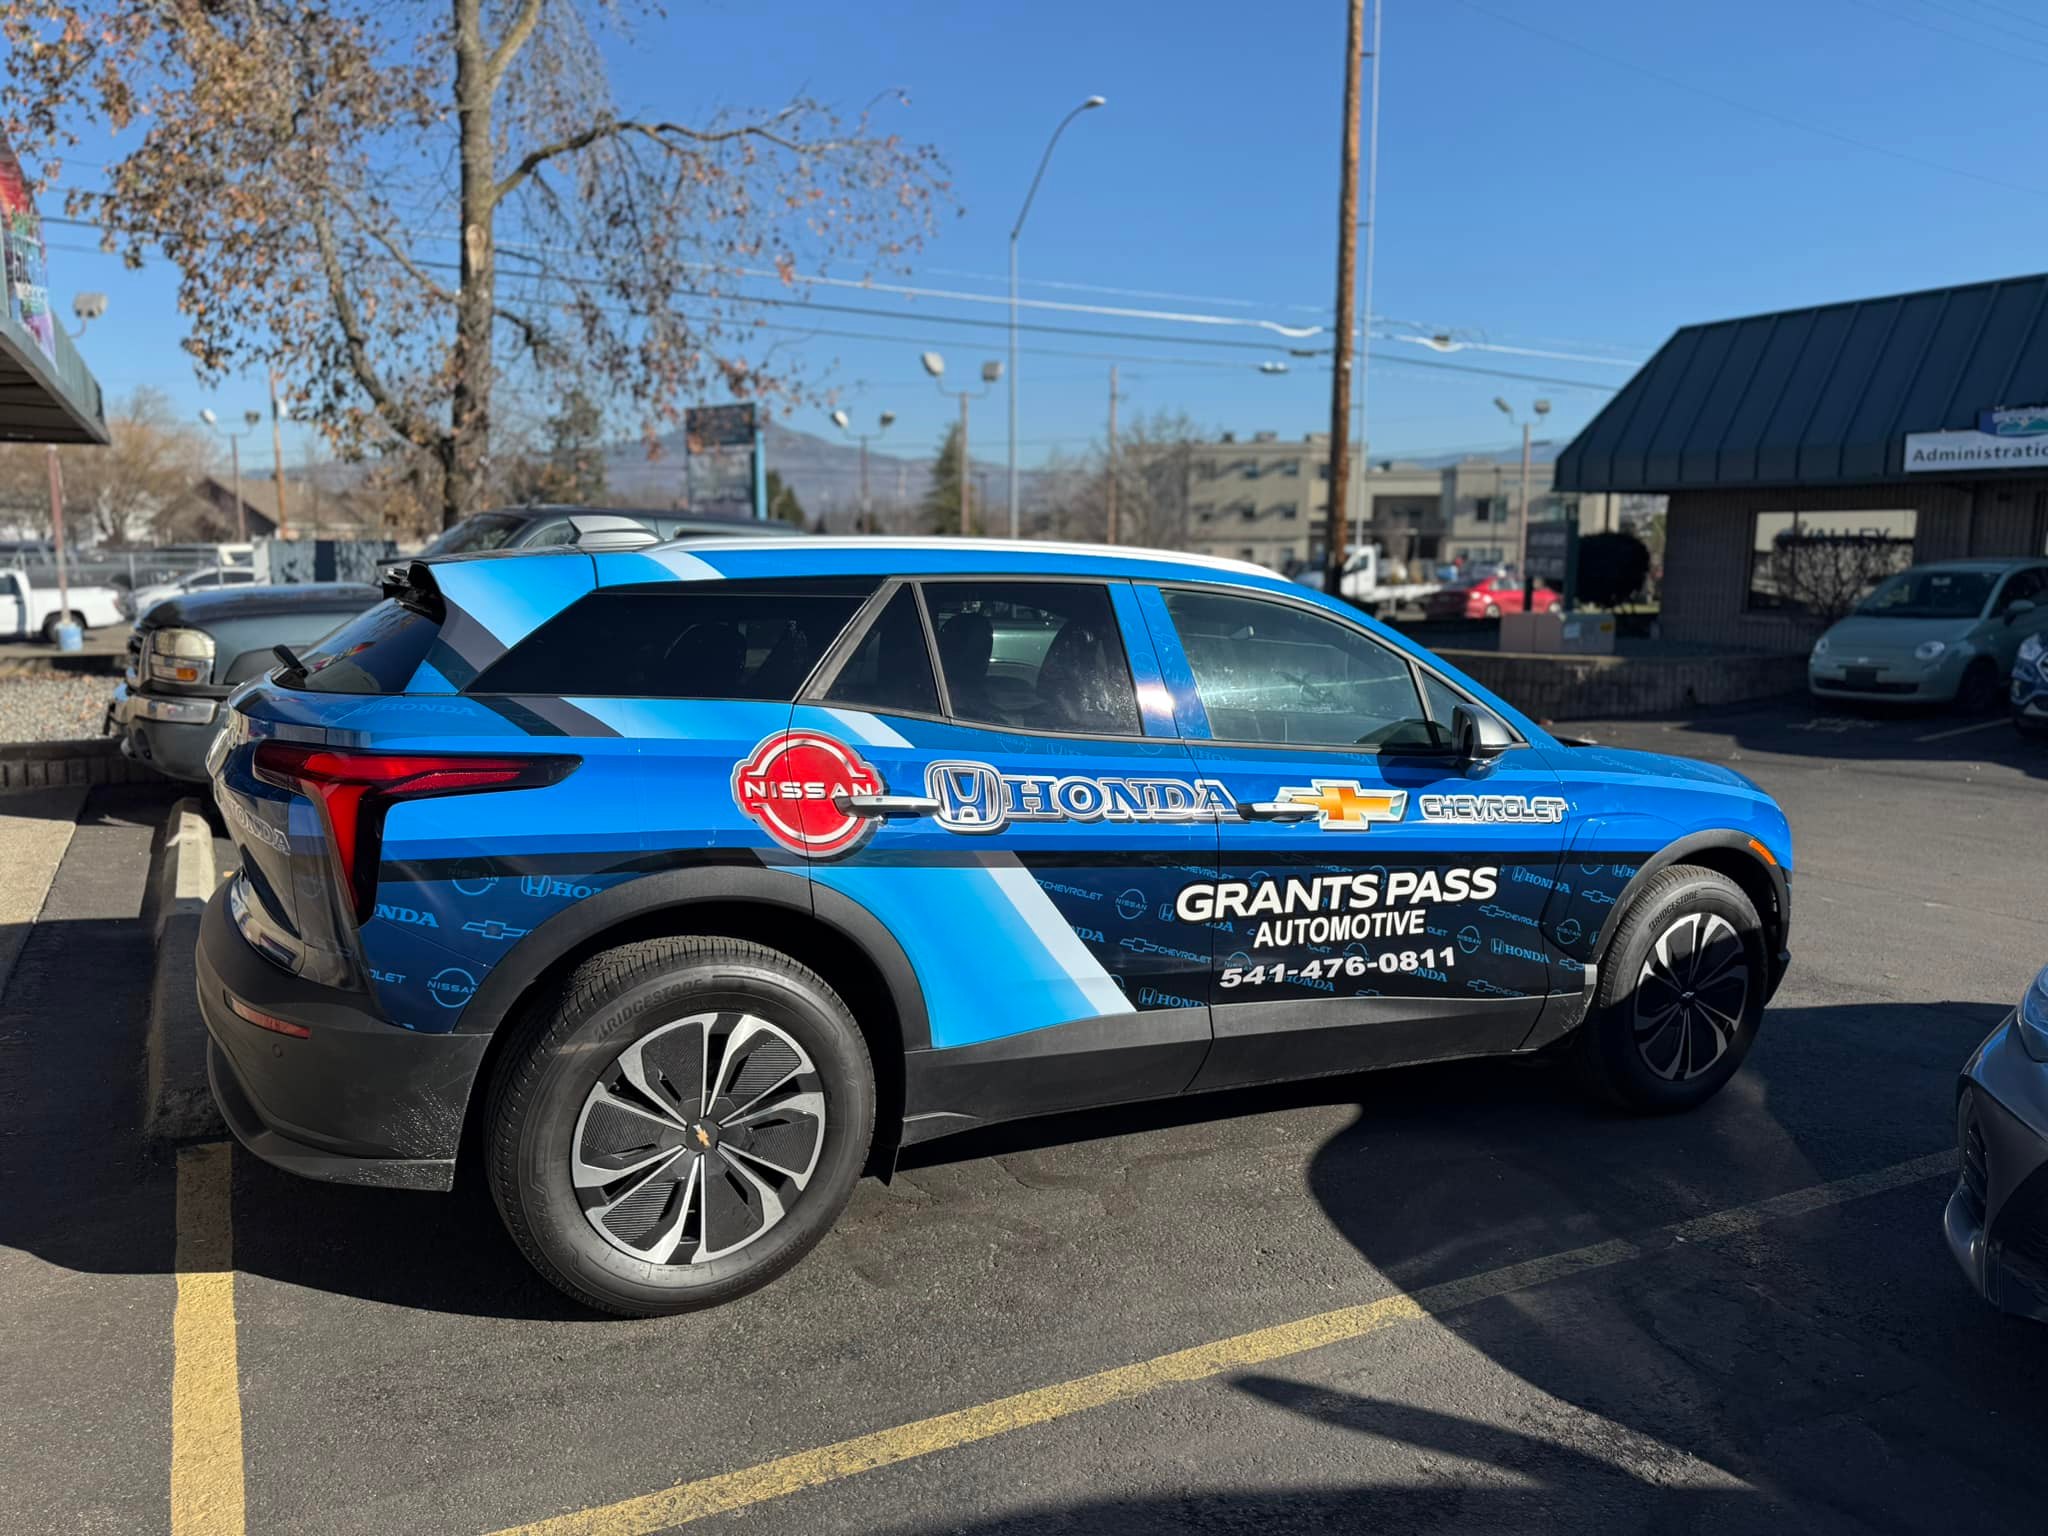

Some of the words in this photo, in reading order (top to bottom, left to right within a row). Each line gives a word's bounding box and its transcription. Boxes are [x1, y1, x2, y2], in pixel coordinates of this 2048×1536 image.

[743, 780, 875, 800] NISSAN
[1001, 775, 1240, 822] HONDA
[1419, 796, 1567, 823] CHEVROLET
[1043, 881, 1104, 902] CHEVROLET
[1115, 897, 1148, 911] NISSAN
[1176, 873, 1379, 922] GRANTS
[1385, 866, 1498, 906] PASS
[375, 903, 439, 928] NDA
[1253, 909, 1426, 949] AUTOMOTIVE
[1158, 946, 1212, 964] CHEVROLET
[1504, 943, 1550, 964] HONDA
[1219, 946, 1455, 988] 541-476-0811
[593, 978, 703, 1042] BRIDGESTONE
